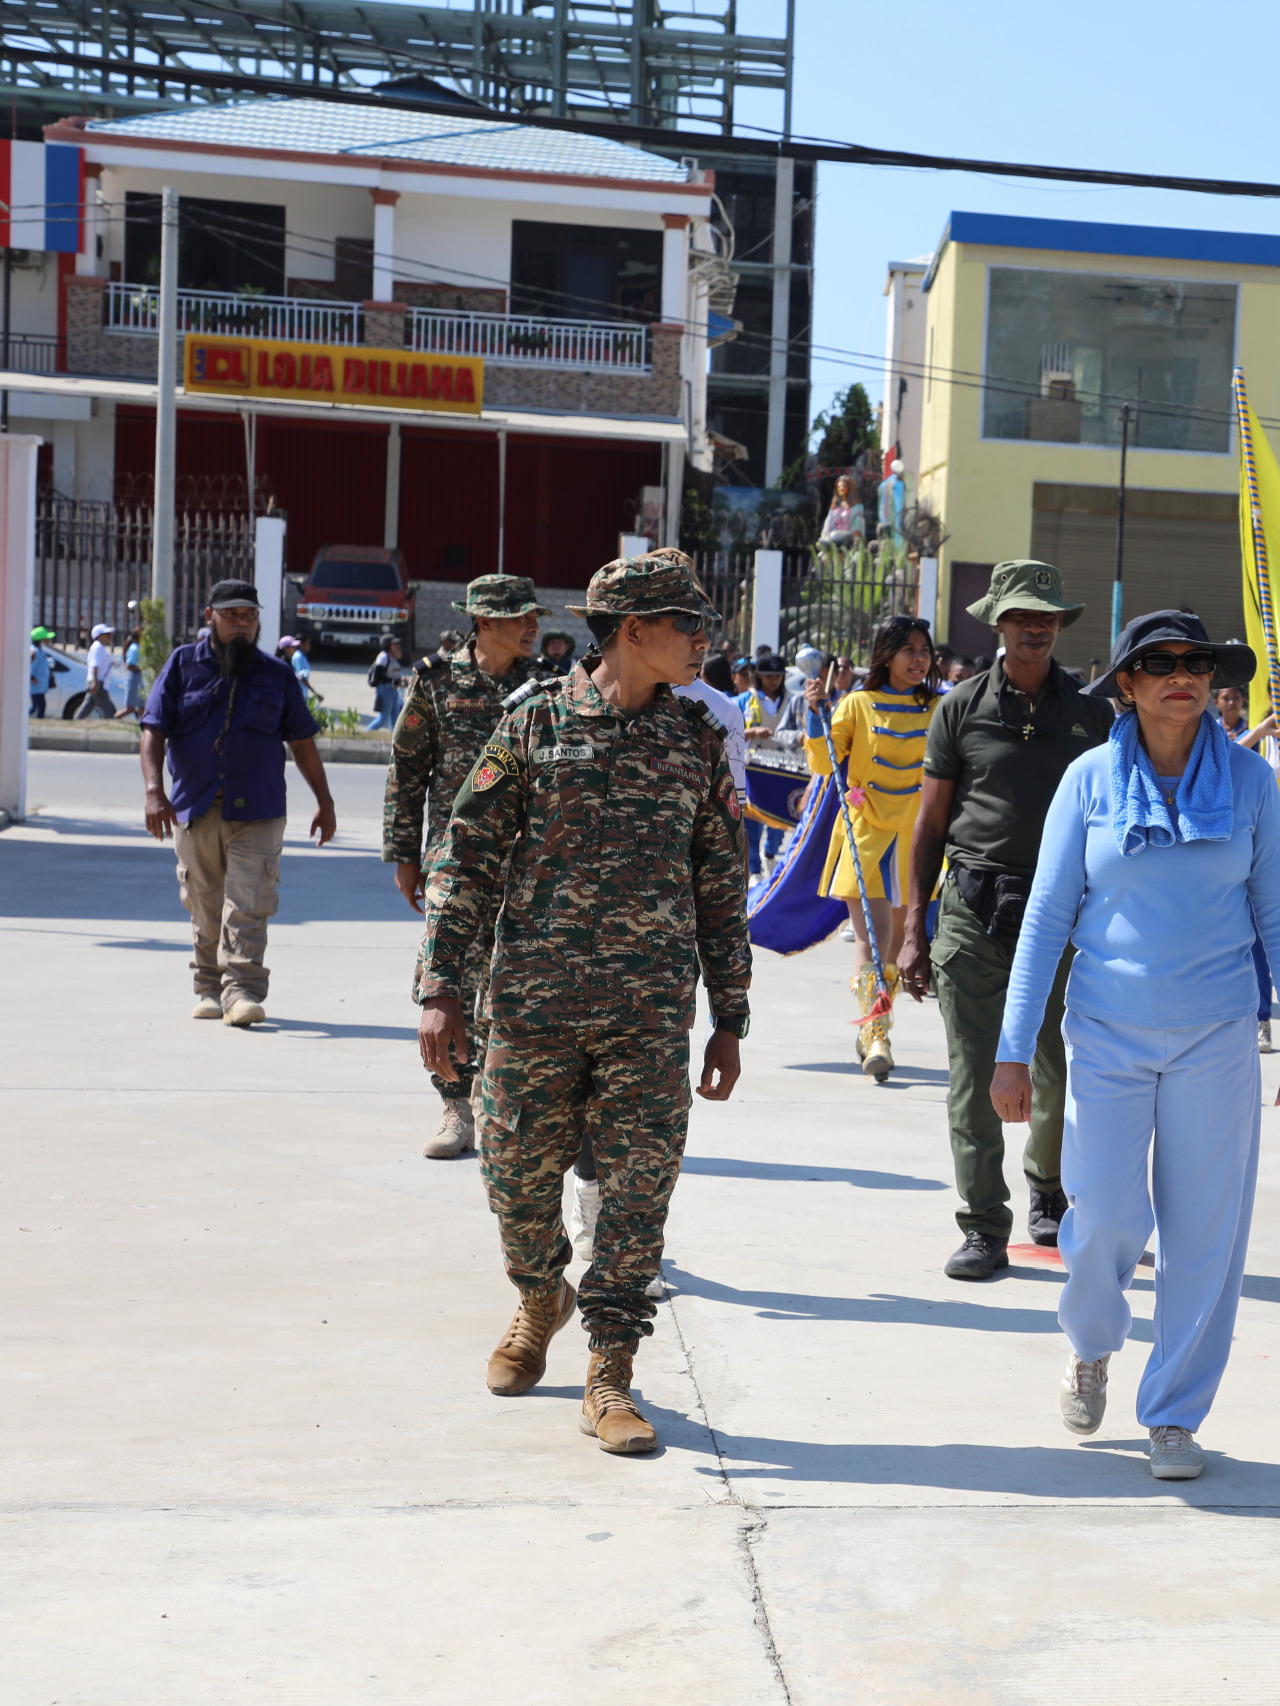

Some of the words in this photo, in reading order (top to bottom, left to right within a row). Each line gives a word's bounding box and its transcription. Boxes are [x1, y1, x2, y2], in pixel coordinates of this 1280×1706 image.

[257, 351, 334, 392] LOJA
[342, 358, 476, 403] DILIANA
[549, 749, 586, 759] SANTOS
[657, 762, 701, 784] INFANTARIA
